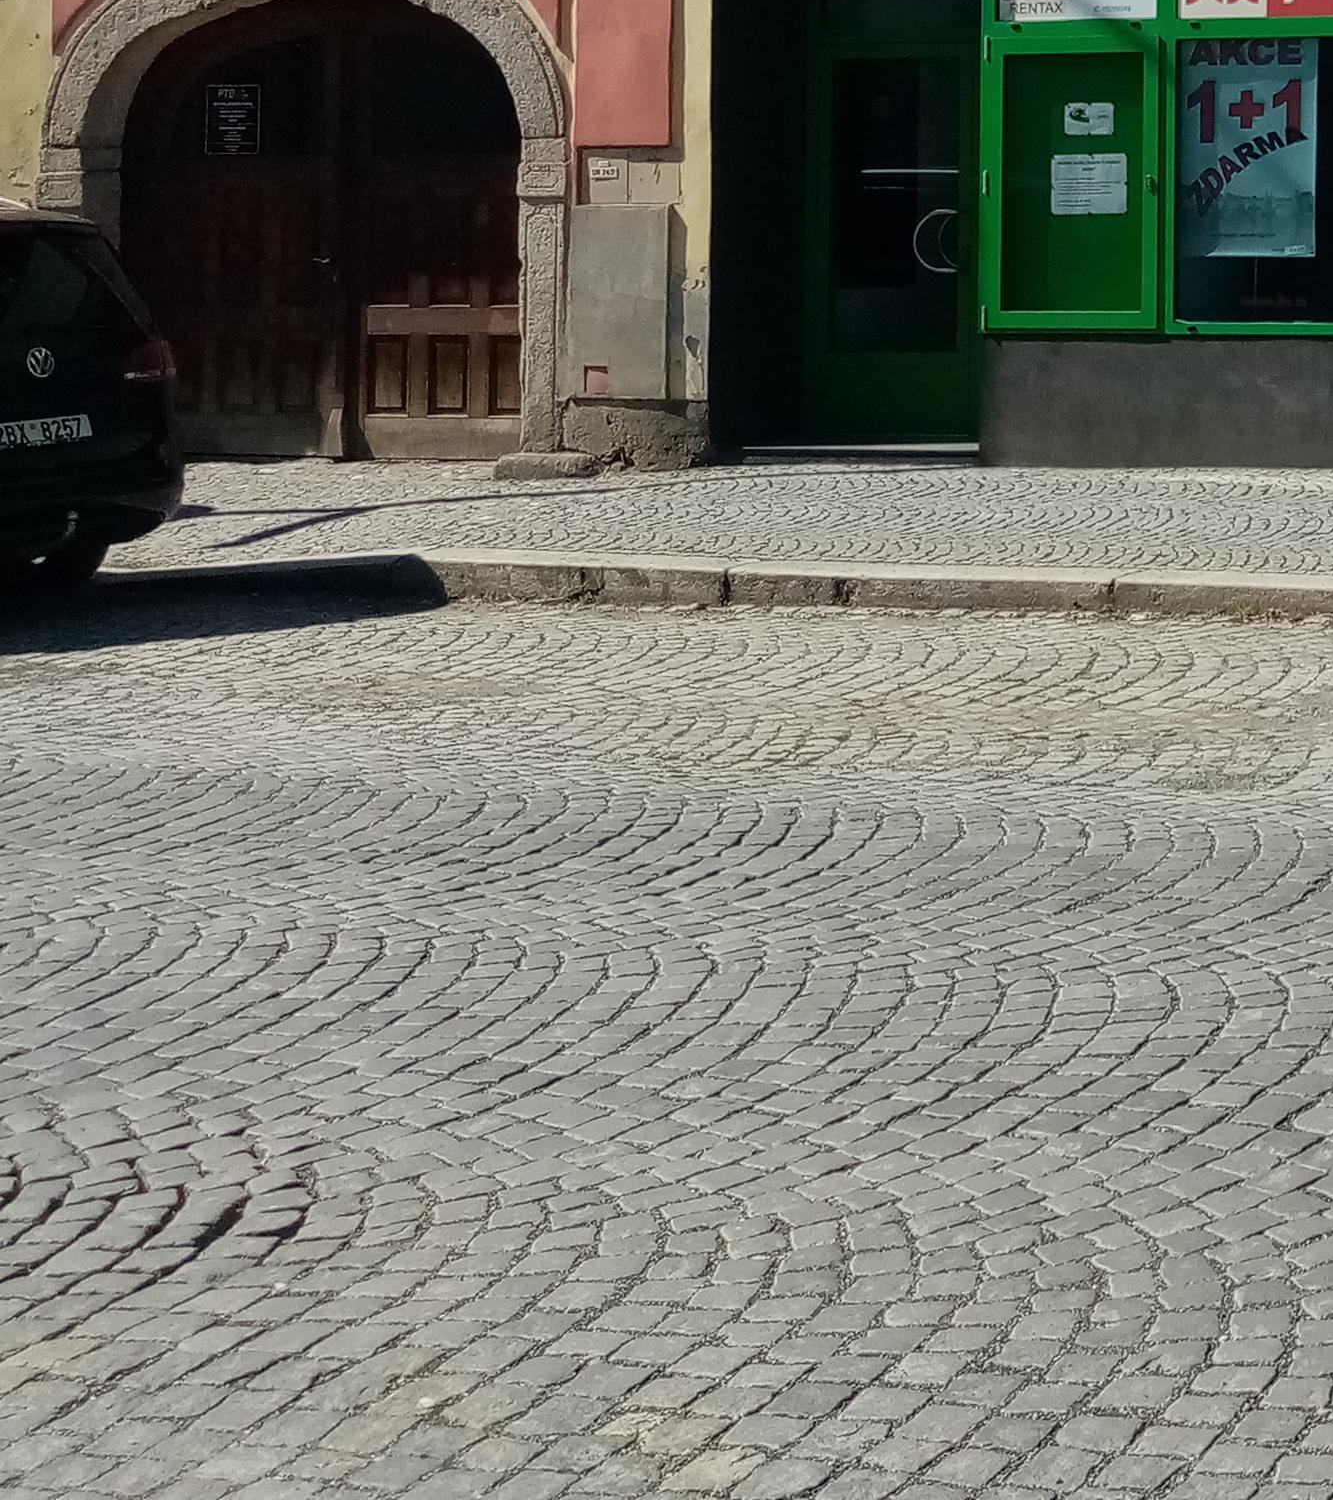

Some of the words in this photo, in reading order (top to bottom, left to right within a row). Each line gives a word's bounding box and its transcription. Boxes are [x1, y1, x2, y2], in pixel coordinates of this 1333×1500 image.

[1010, 2, 1063, 14] RENTAX
[1189, 39, 1303, 66] AKCE
[1187, 79, 1303, 143] 1+1
[1186, 128, 1309, 218] ZDARMA
